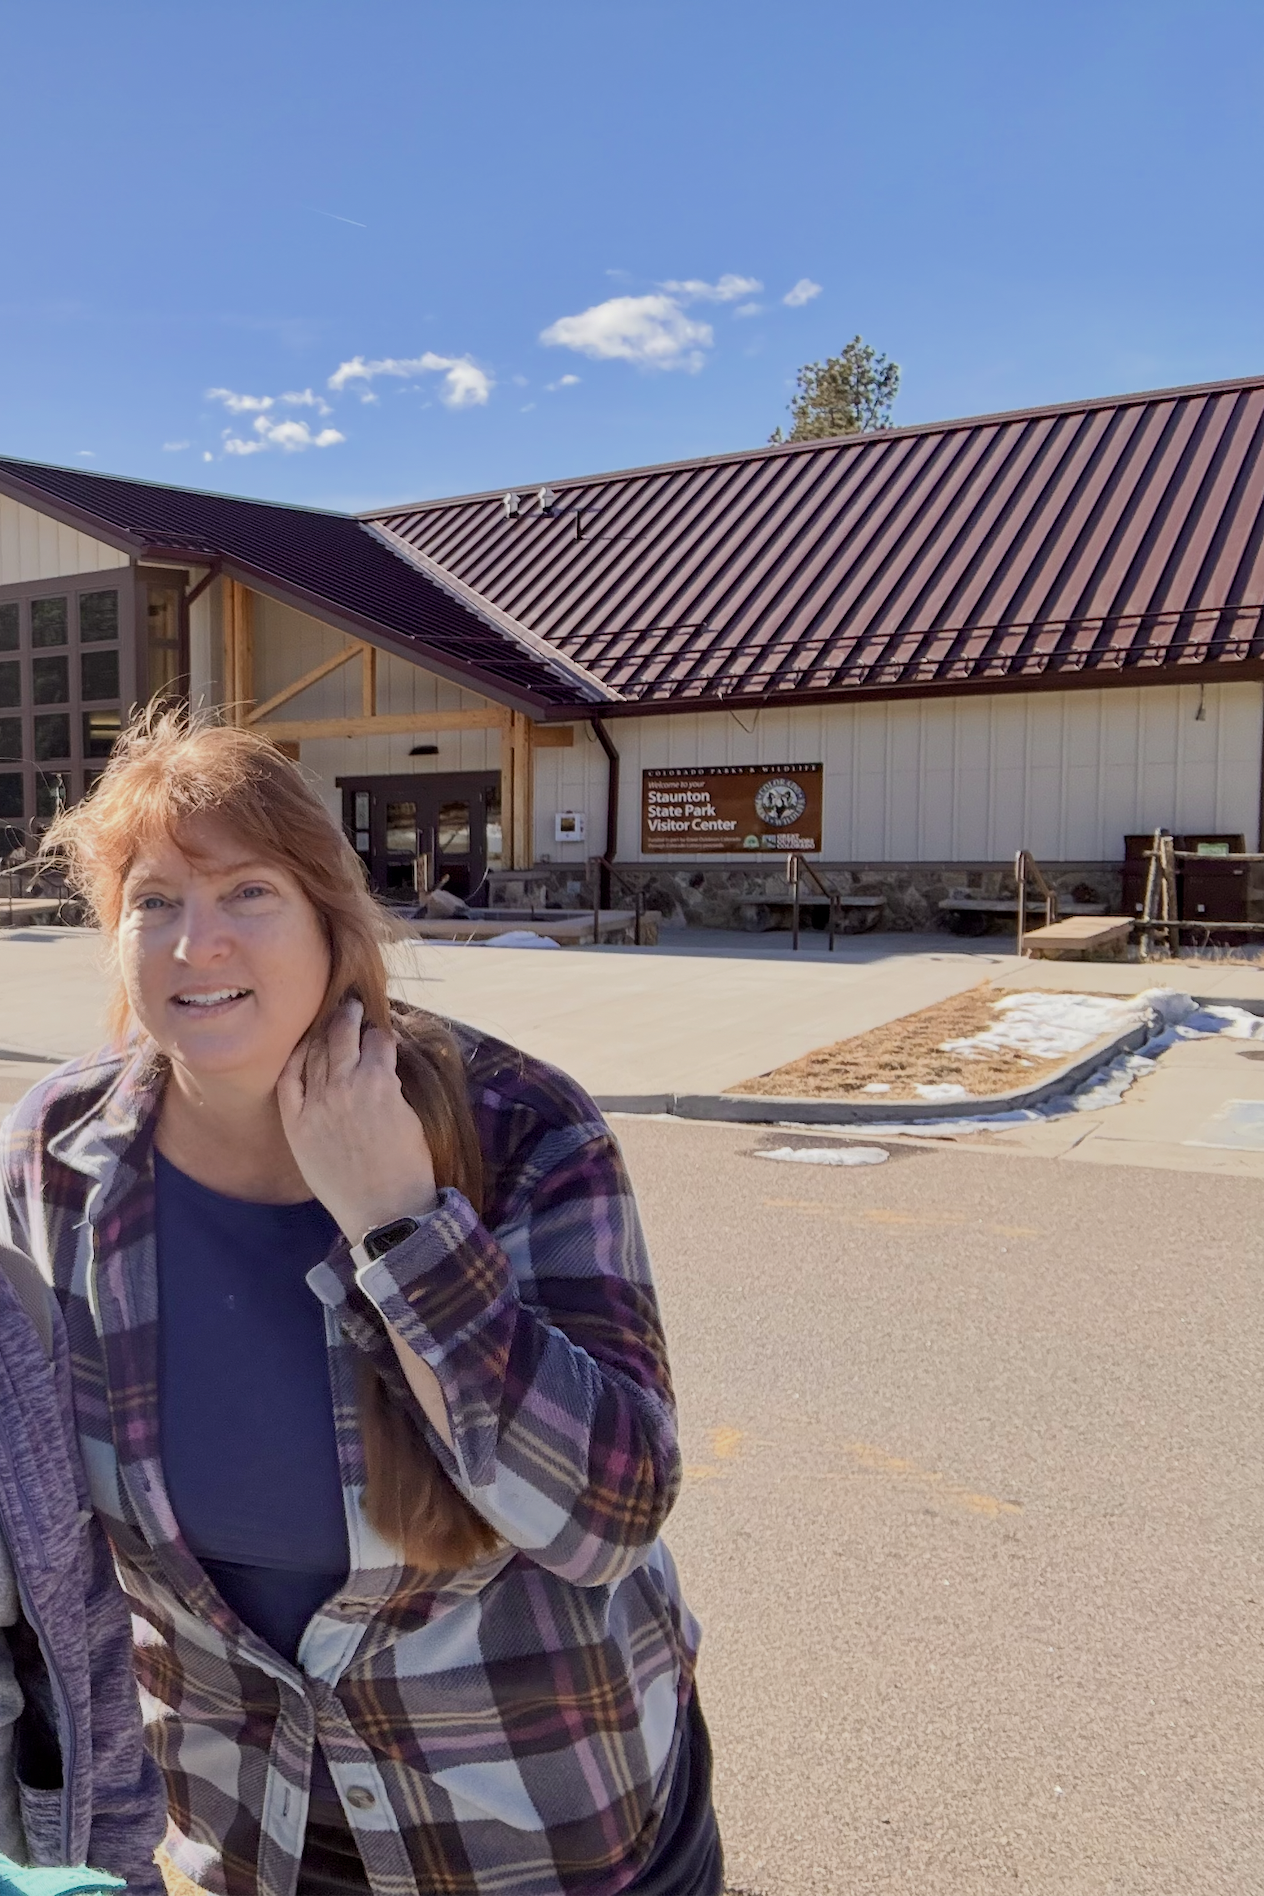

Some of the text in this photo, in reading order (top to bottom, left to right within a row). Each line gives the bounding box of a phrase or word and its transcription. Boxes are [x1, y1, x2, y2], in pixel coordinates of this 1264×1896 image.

[648, 768, 705, 777] COLORADO
[710, 767, 744, 775] PARKS
[762, 764, 816, 773] WILDLIFE
[648, 781, 706, 790] Welcome to your
[648, 791, 711, 803] Staunton
[648, 803, 716, 818] State Park
[647, 818, 737, 832] Visitor Center
